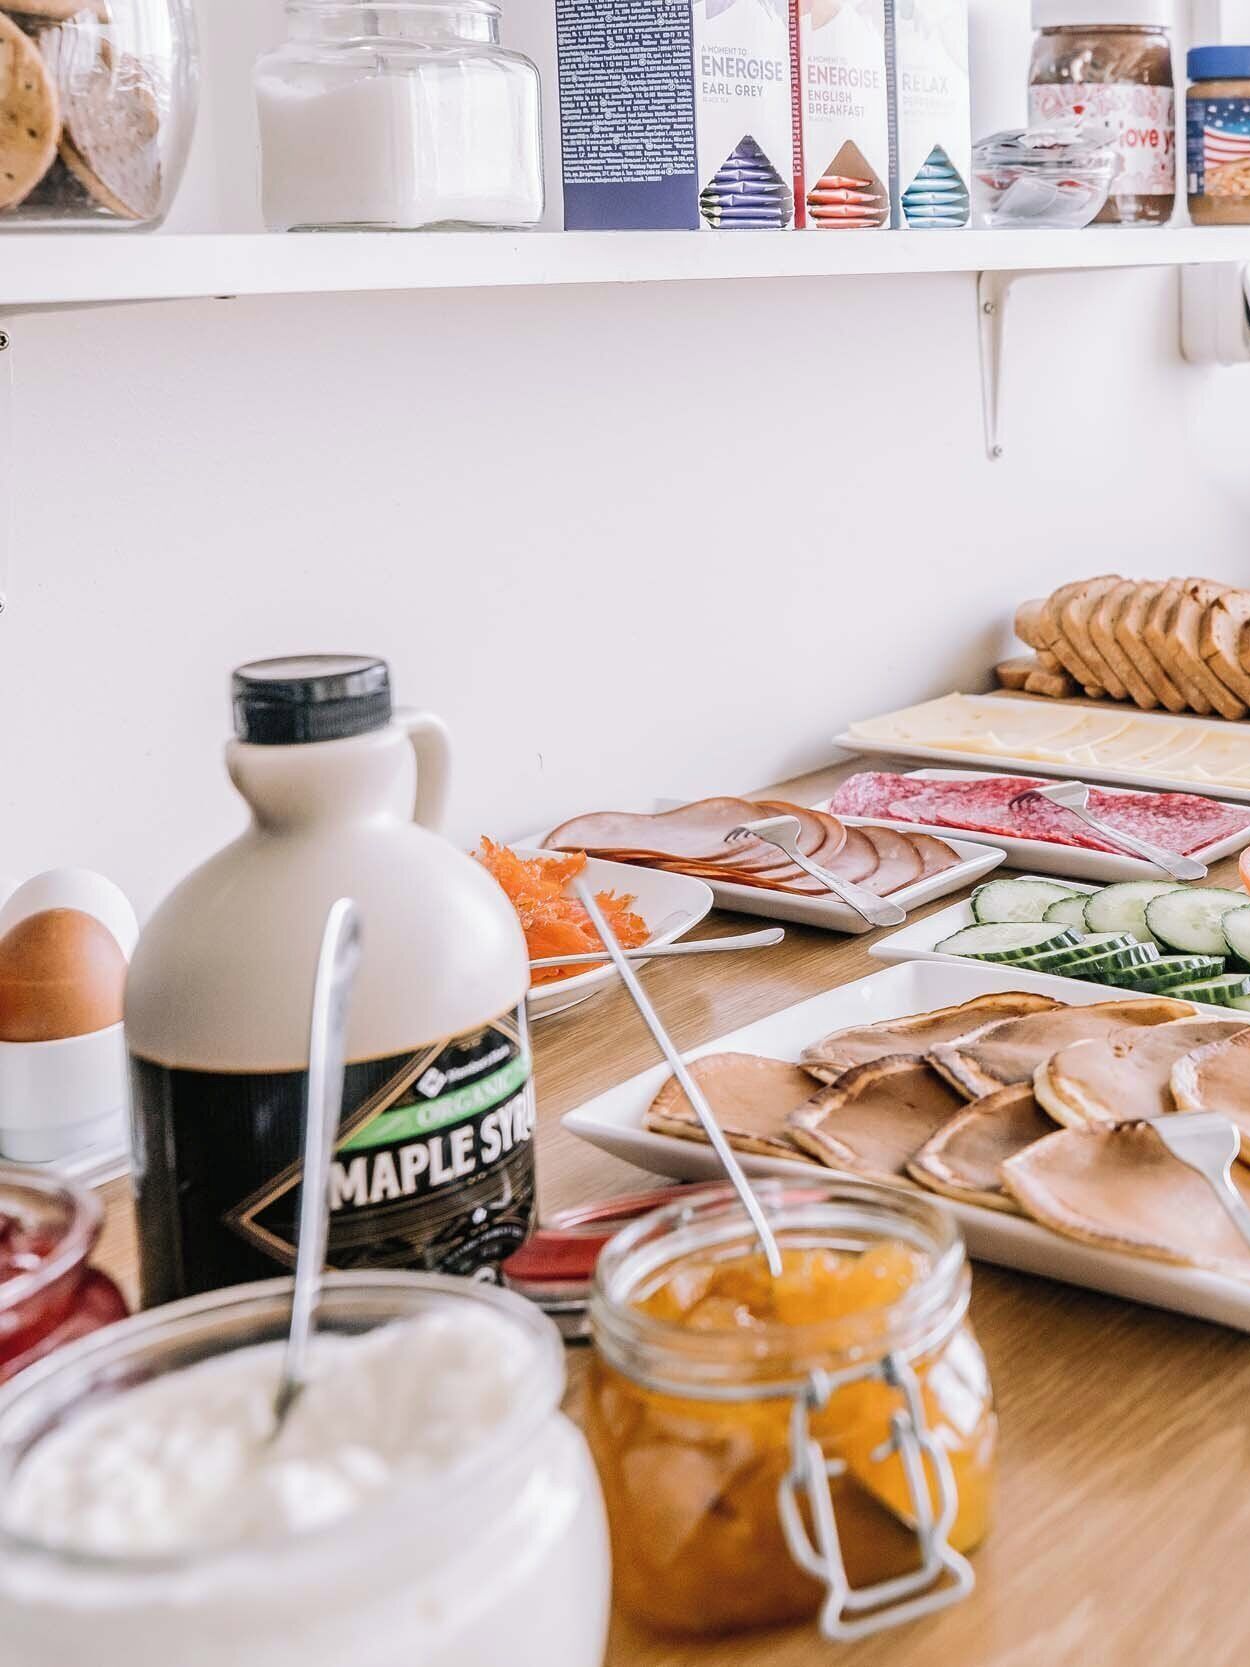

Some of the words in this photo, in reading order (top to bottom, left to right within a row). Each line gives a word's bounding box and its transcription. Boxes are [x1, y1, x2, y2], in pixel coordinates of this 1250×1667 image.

[701, 45, 706, 53] A
[708, 46, 737, 55] MOMENT
[738, 47, 748, 56] TO
[701, 55, 783, 81] ENERGISE
[807, 65, 880, 88] ENERGISE
[702, 82, 732, 96] EARL
[735, 84, 764, 97] GREY
[902, 72, 949, 96] RELAX
[808, 90, 852, 103] ENGLISH
[808, 103, 865, 118] BREAKFAST
[416, 1067, 514, 1127] ORGANIC
[328, 1124, 477, 1211] MAPLE
